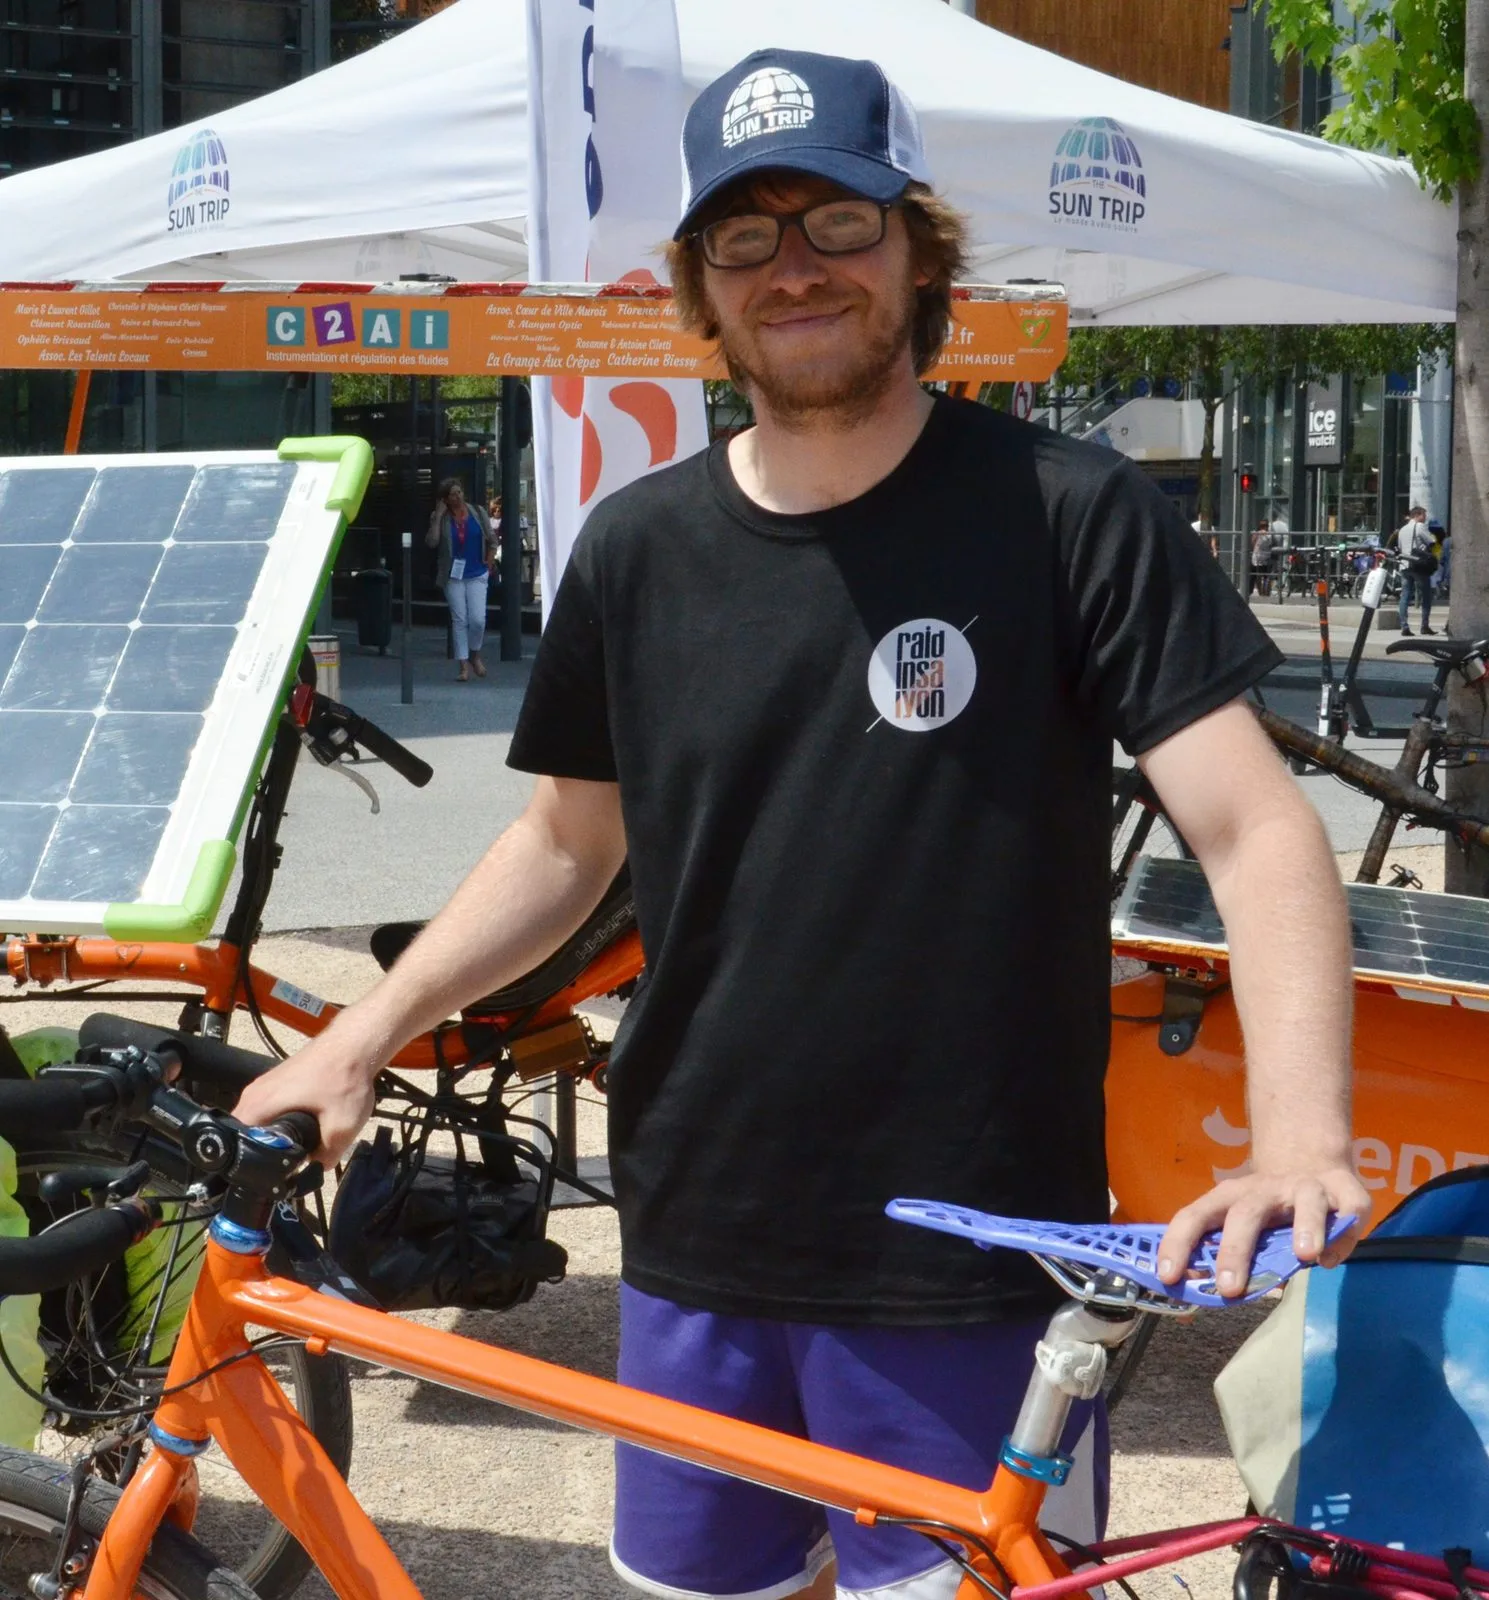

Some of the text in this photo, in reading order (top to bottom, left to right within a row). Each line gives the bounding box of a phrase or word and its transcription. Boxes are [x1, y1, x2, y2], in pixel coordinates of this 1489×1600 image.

[723, 115, 761, 147] SUN
[763, 109, 814, 127] TRIP
[167, 204, 195, 231] SUN
[199, 198, 230, 223] TRIP
[1049, 191, 1145, 224] SUN TRIP
[540, 305, 552, 316] de
[554, 304, 573, 316] Ville
[617, 304, 659, 316] Florence
[266, 350, 449, 365] Instrumentation et régulation des fluides
[486, 353, 601, 372] La Grange Aux Crêpes
[607, 352, 660, 367] Catherine
[932, 352, 1017, 365] ULTIMARQUE
[1308, 401, 1336, 432] ice
[1308, 434, 1336, 447] watch
[896, 625, 945, 662] raid
[895, 660, 944, 690] insa
[895, 689, 945, 719] lyon
